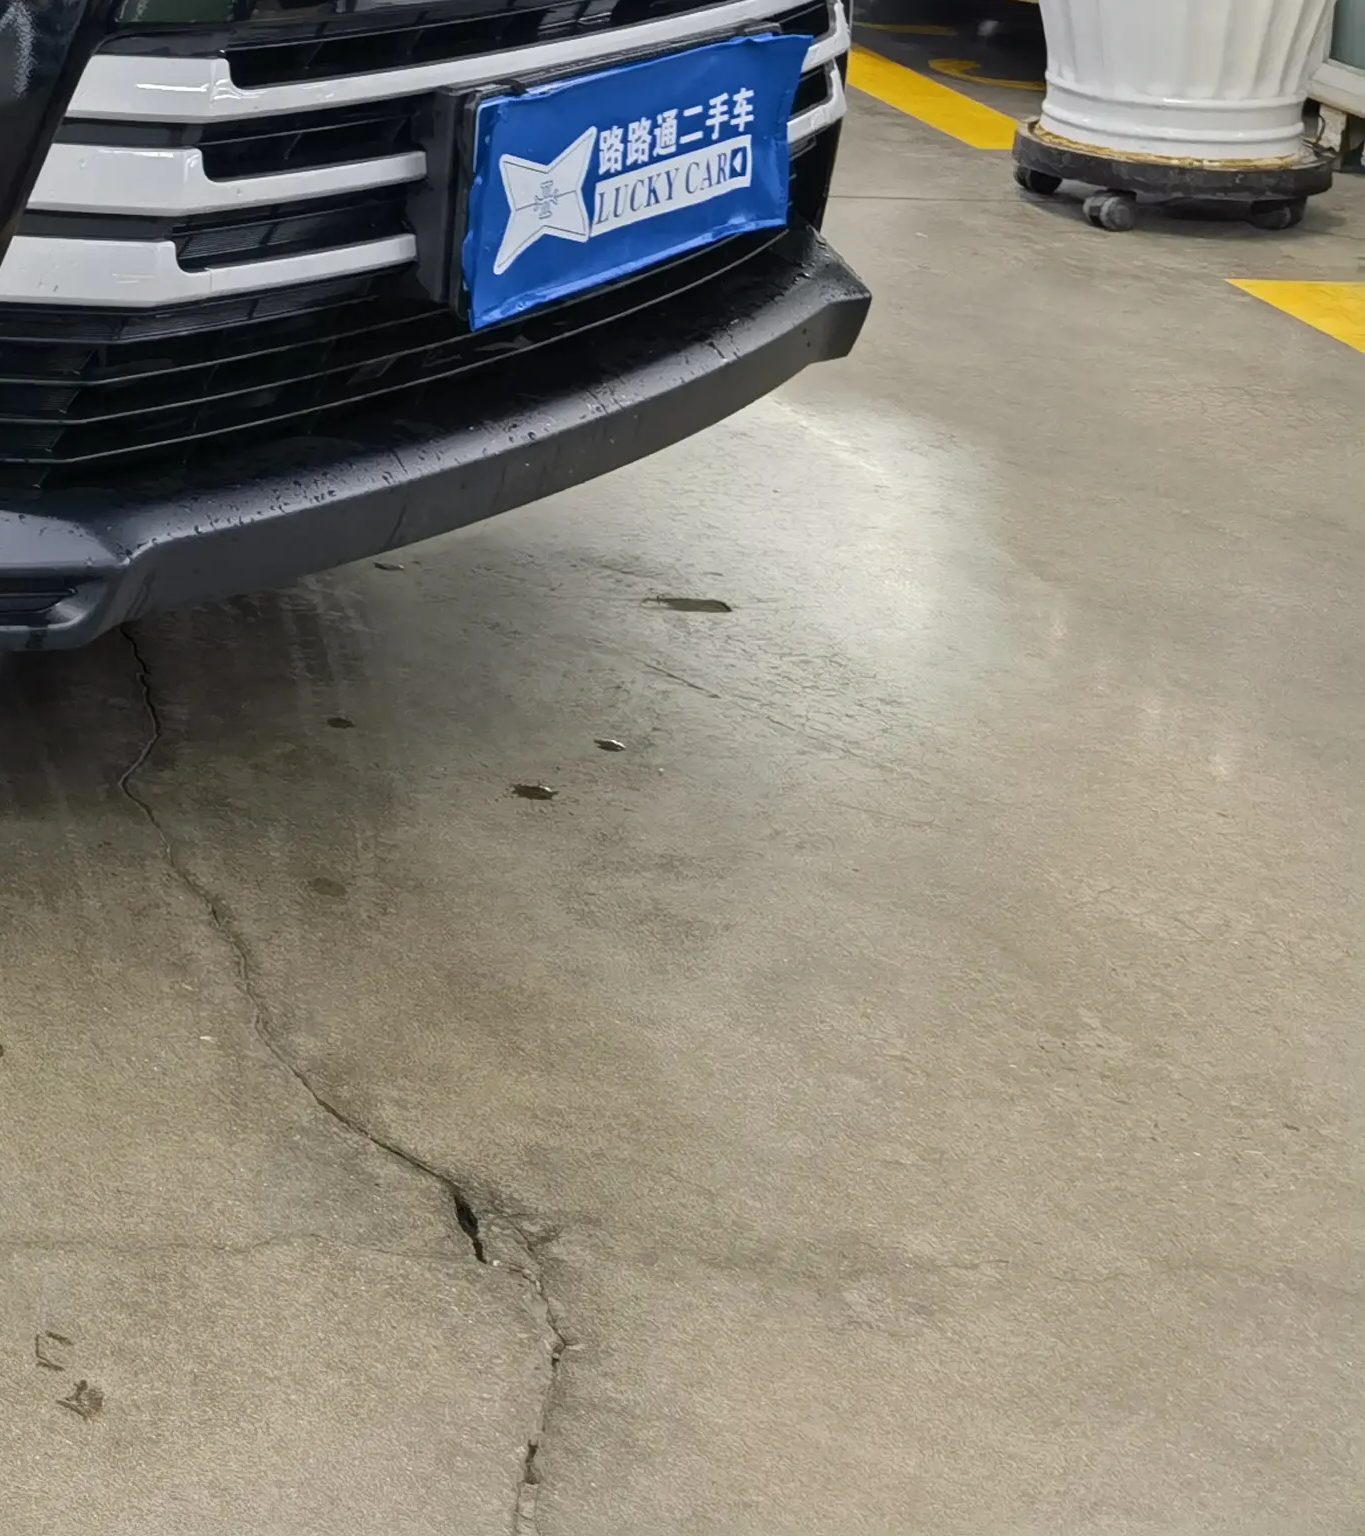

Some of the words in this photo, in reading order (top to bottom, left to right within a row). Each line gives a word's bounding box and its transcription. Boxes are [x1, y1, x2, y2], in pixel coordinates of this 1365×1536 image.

[598, 87, 755, 176] 路路通二手车
[595, 167, 680, 225] LUCKY
[685, 152, 730, 195] CAR
